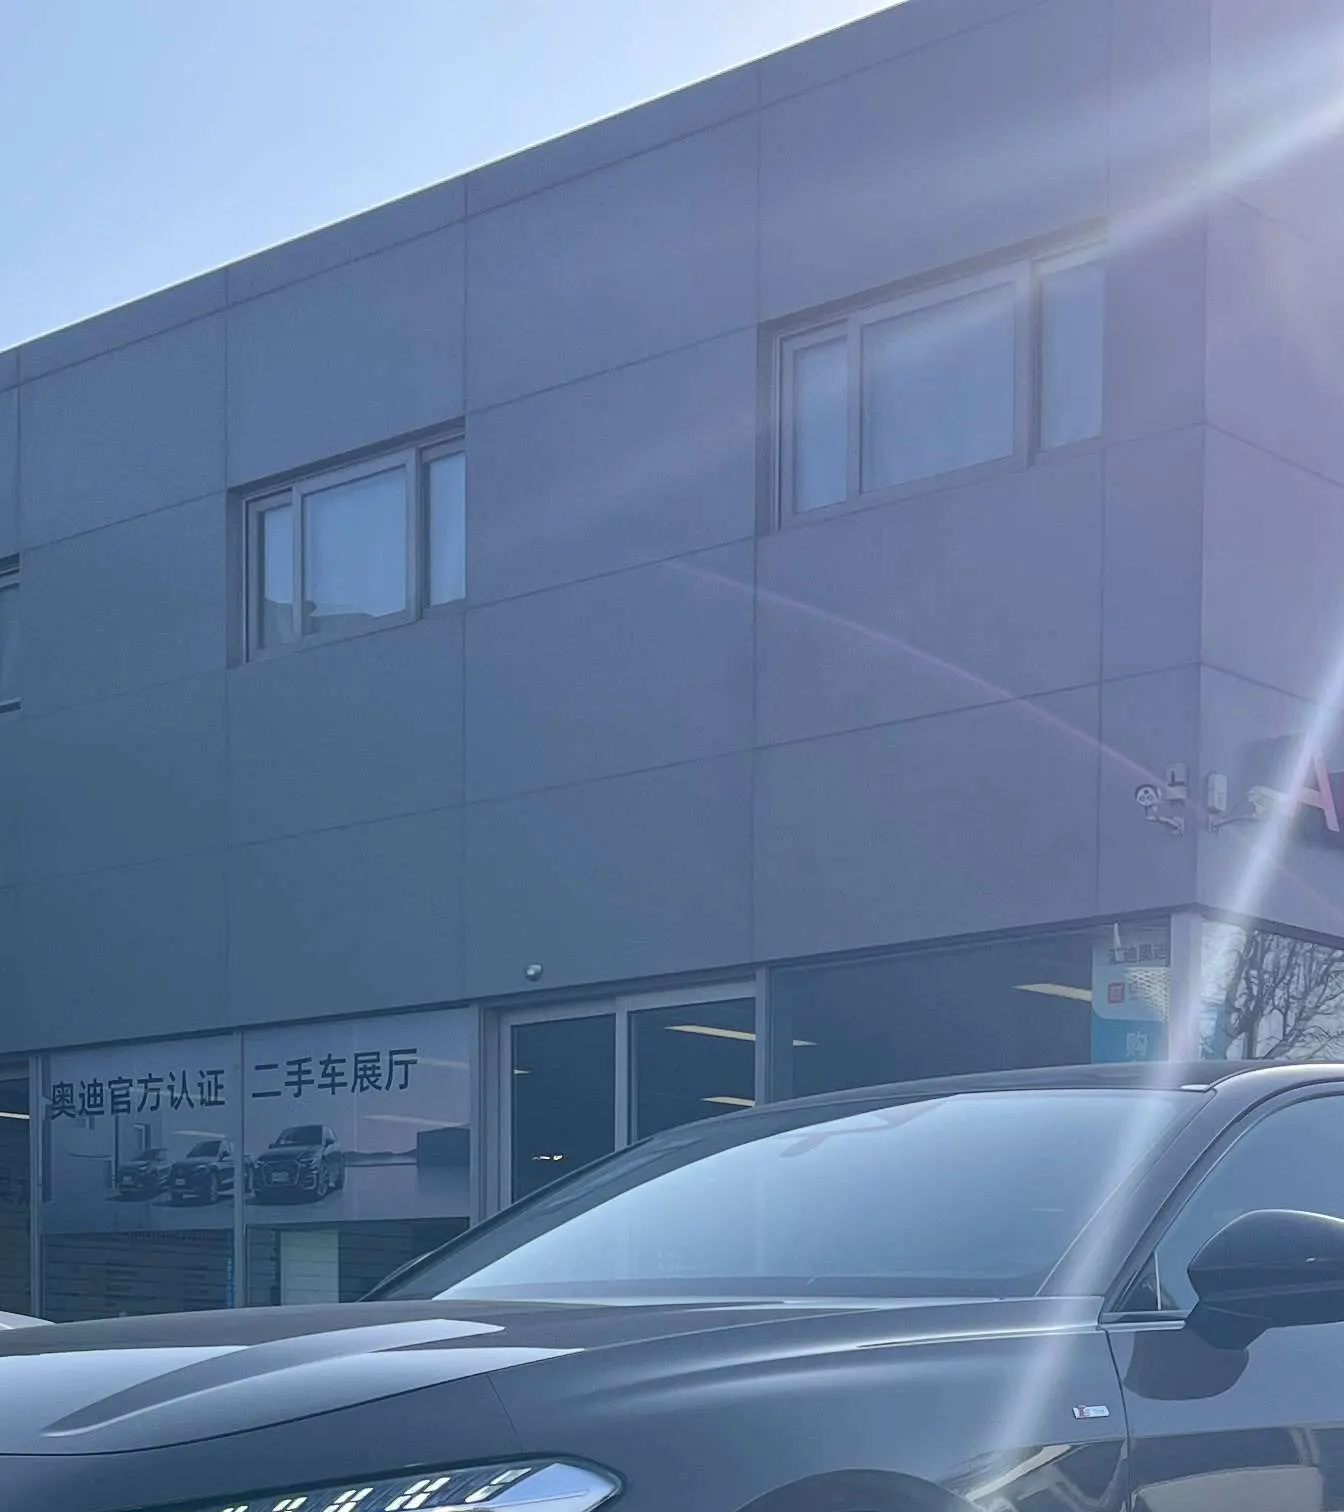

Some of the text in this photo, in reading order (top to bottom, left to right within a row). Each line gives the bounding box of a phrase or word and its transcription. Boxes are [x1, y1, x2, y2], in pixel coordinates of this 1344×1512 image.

[50, 1047, 418, 1120] 奥迪官方认证 二手车展厅
